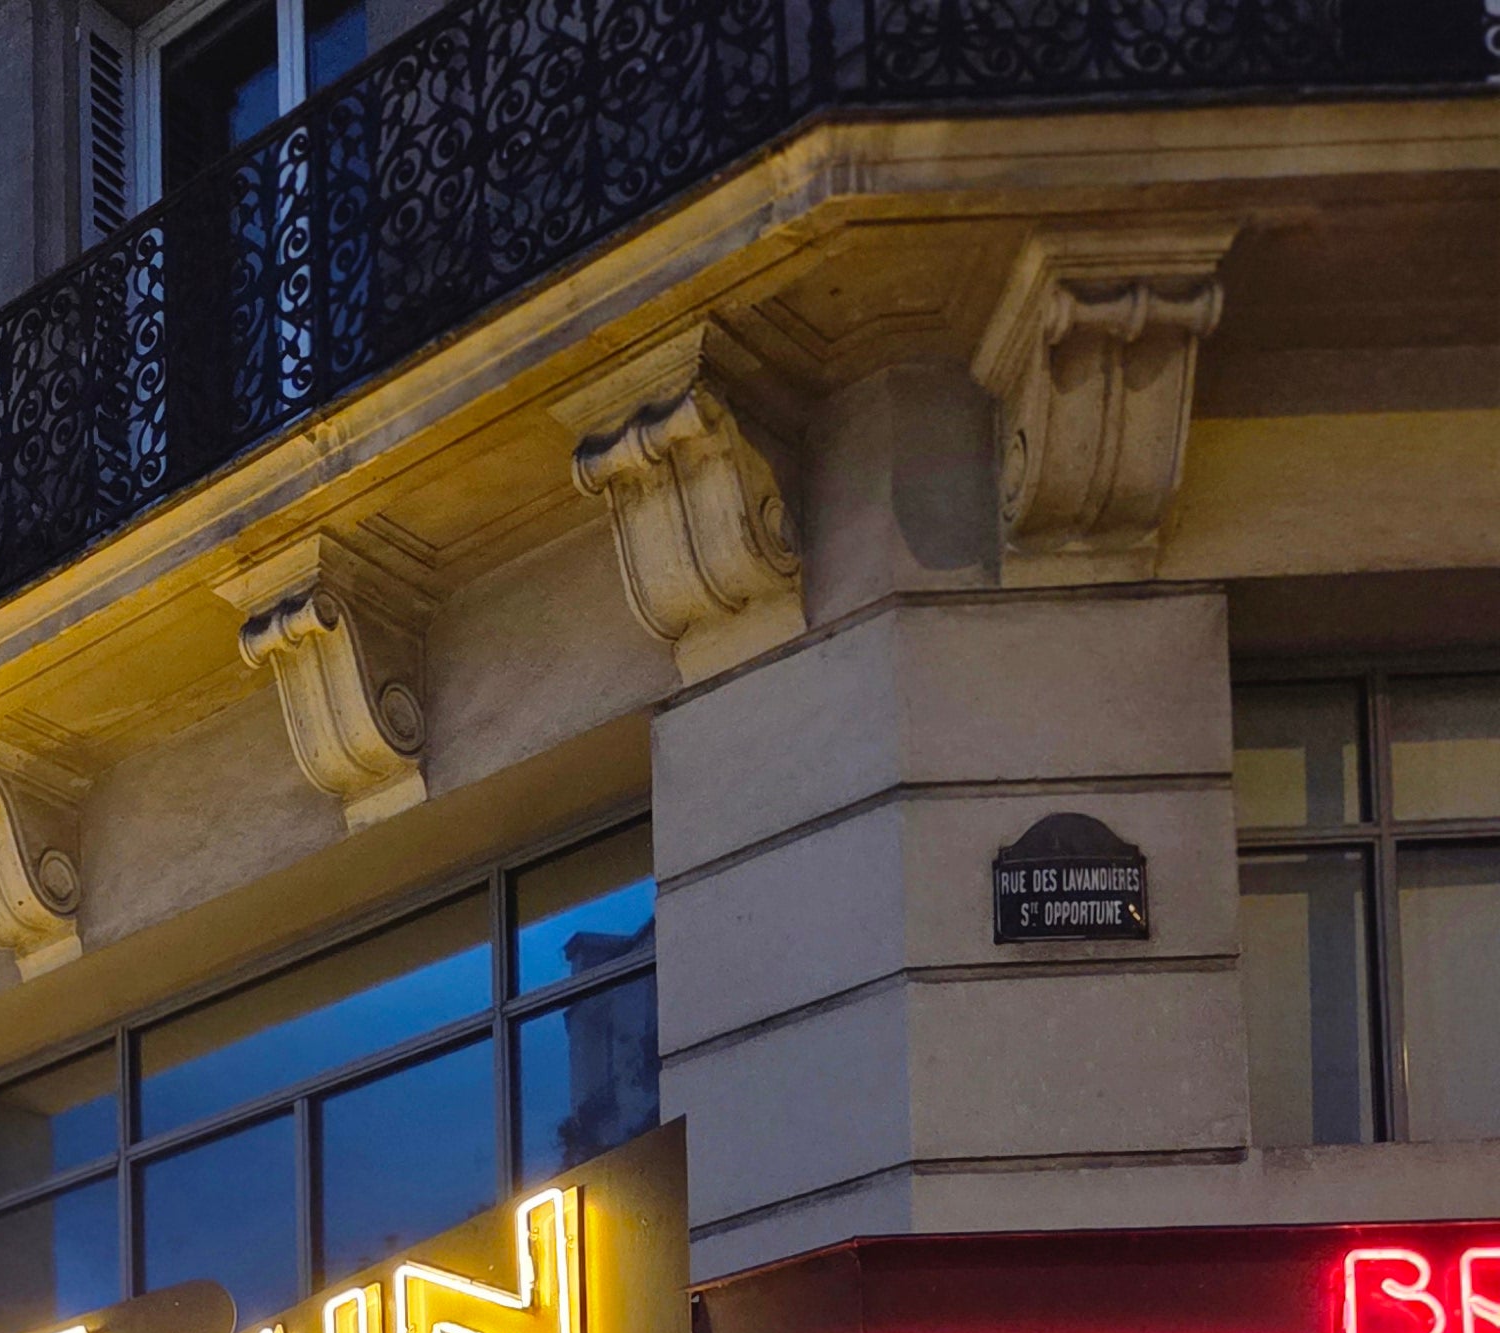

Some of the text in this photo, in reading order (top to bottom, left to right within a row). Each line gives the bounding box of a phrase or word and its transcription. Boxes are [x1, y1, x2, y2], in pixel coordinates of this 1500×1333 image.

[1001, 869, 1027, 895] RUE
[1032, 868, 1058, 893] DES
[1044, 900, 1123, 926] OPPORTUNE
